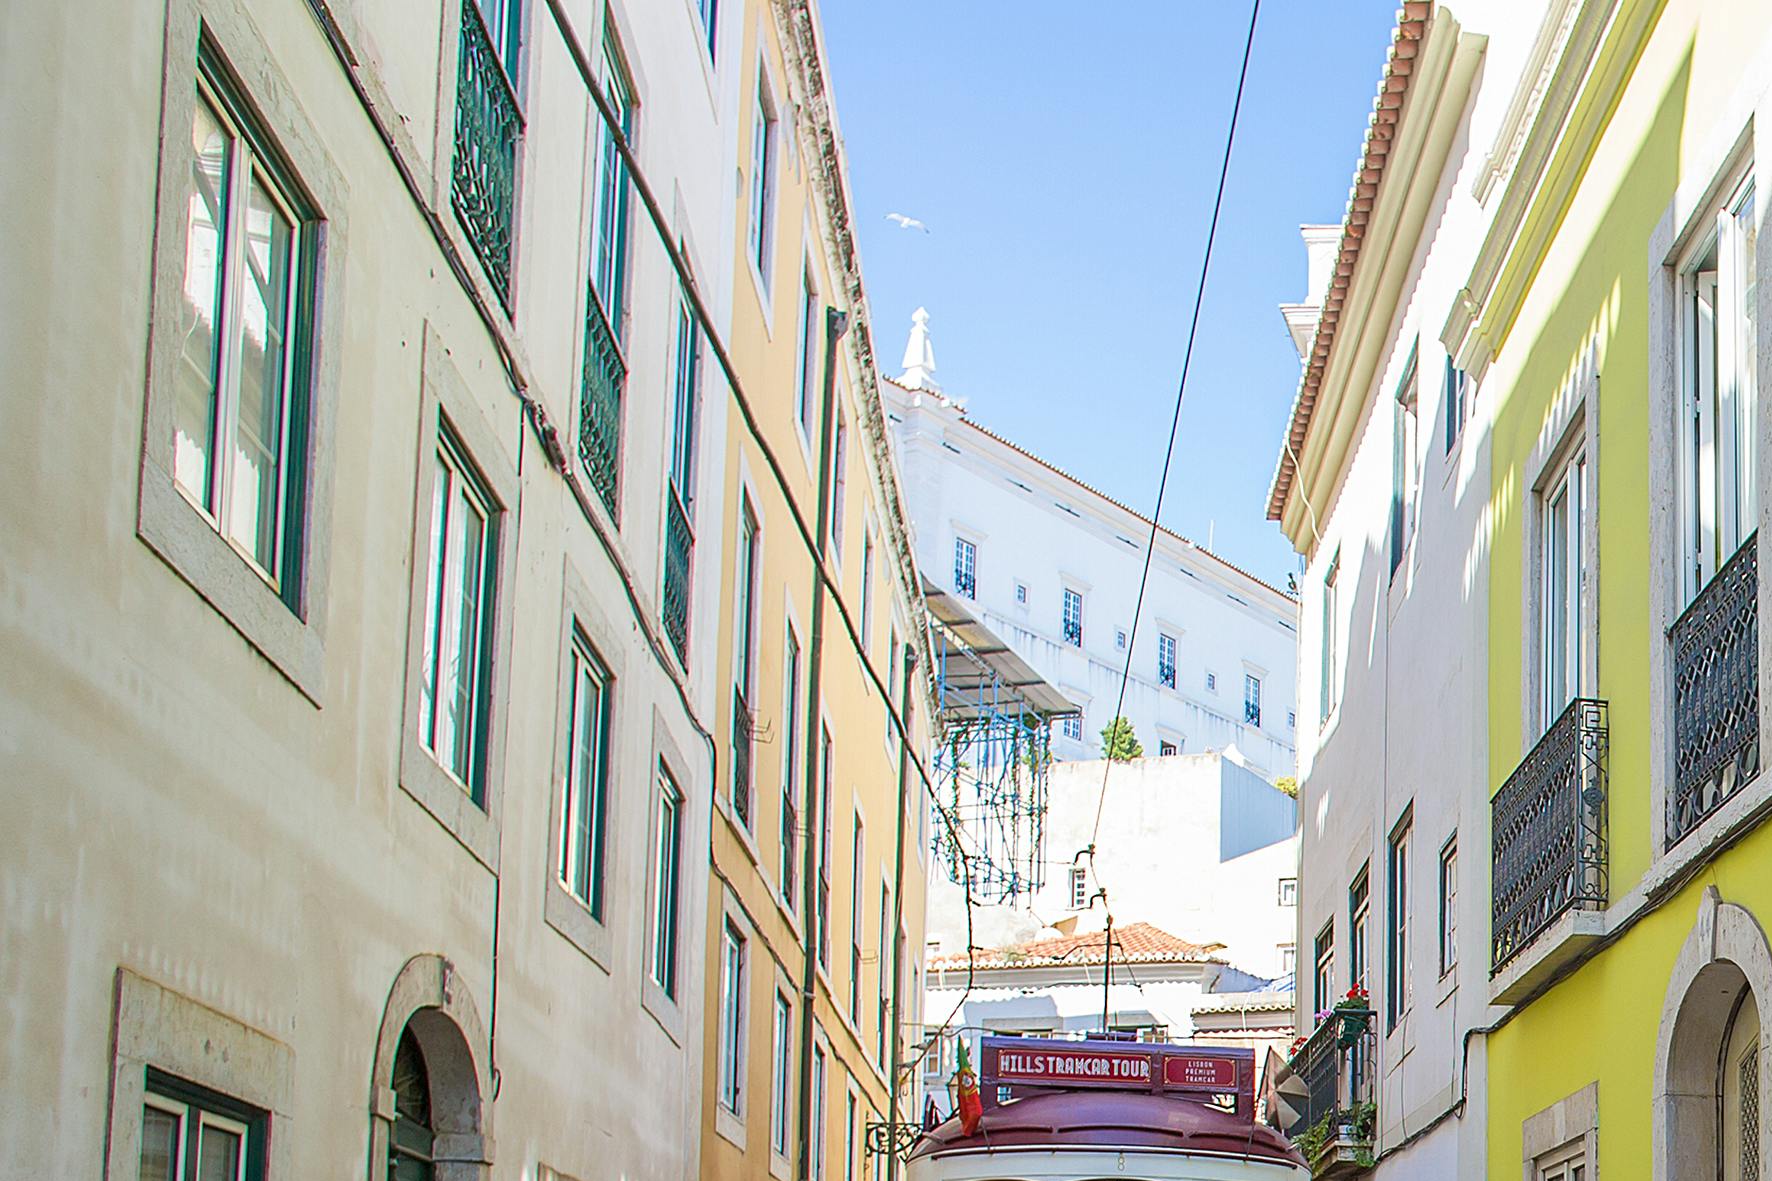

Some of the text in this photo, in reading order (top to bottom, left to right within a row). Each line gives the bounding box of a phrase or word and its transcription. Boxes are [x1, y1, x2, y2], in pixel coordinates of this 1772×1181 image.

[1000, 1055, 1149, 1077] HILLS TRAMCAR TOUR
[1185, 1068, 1216, 1076] PREMIUM
[1185, 1075, 1216, 1083] TRAMCAR
